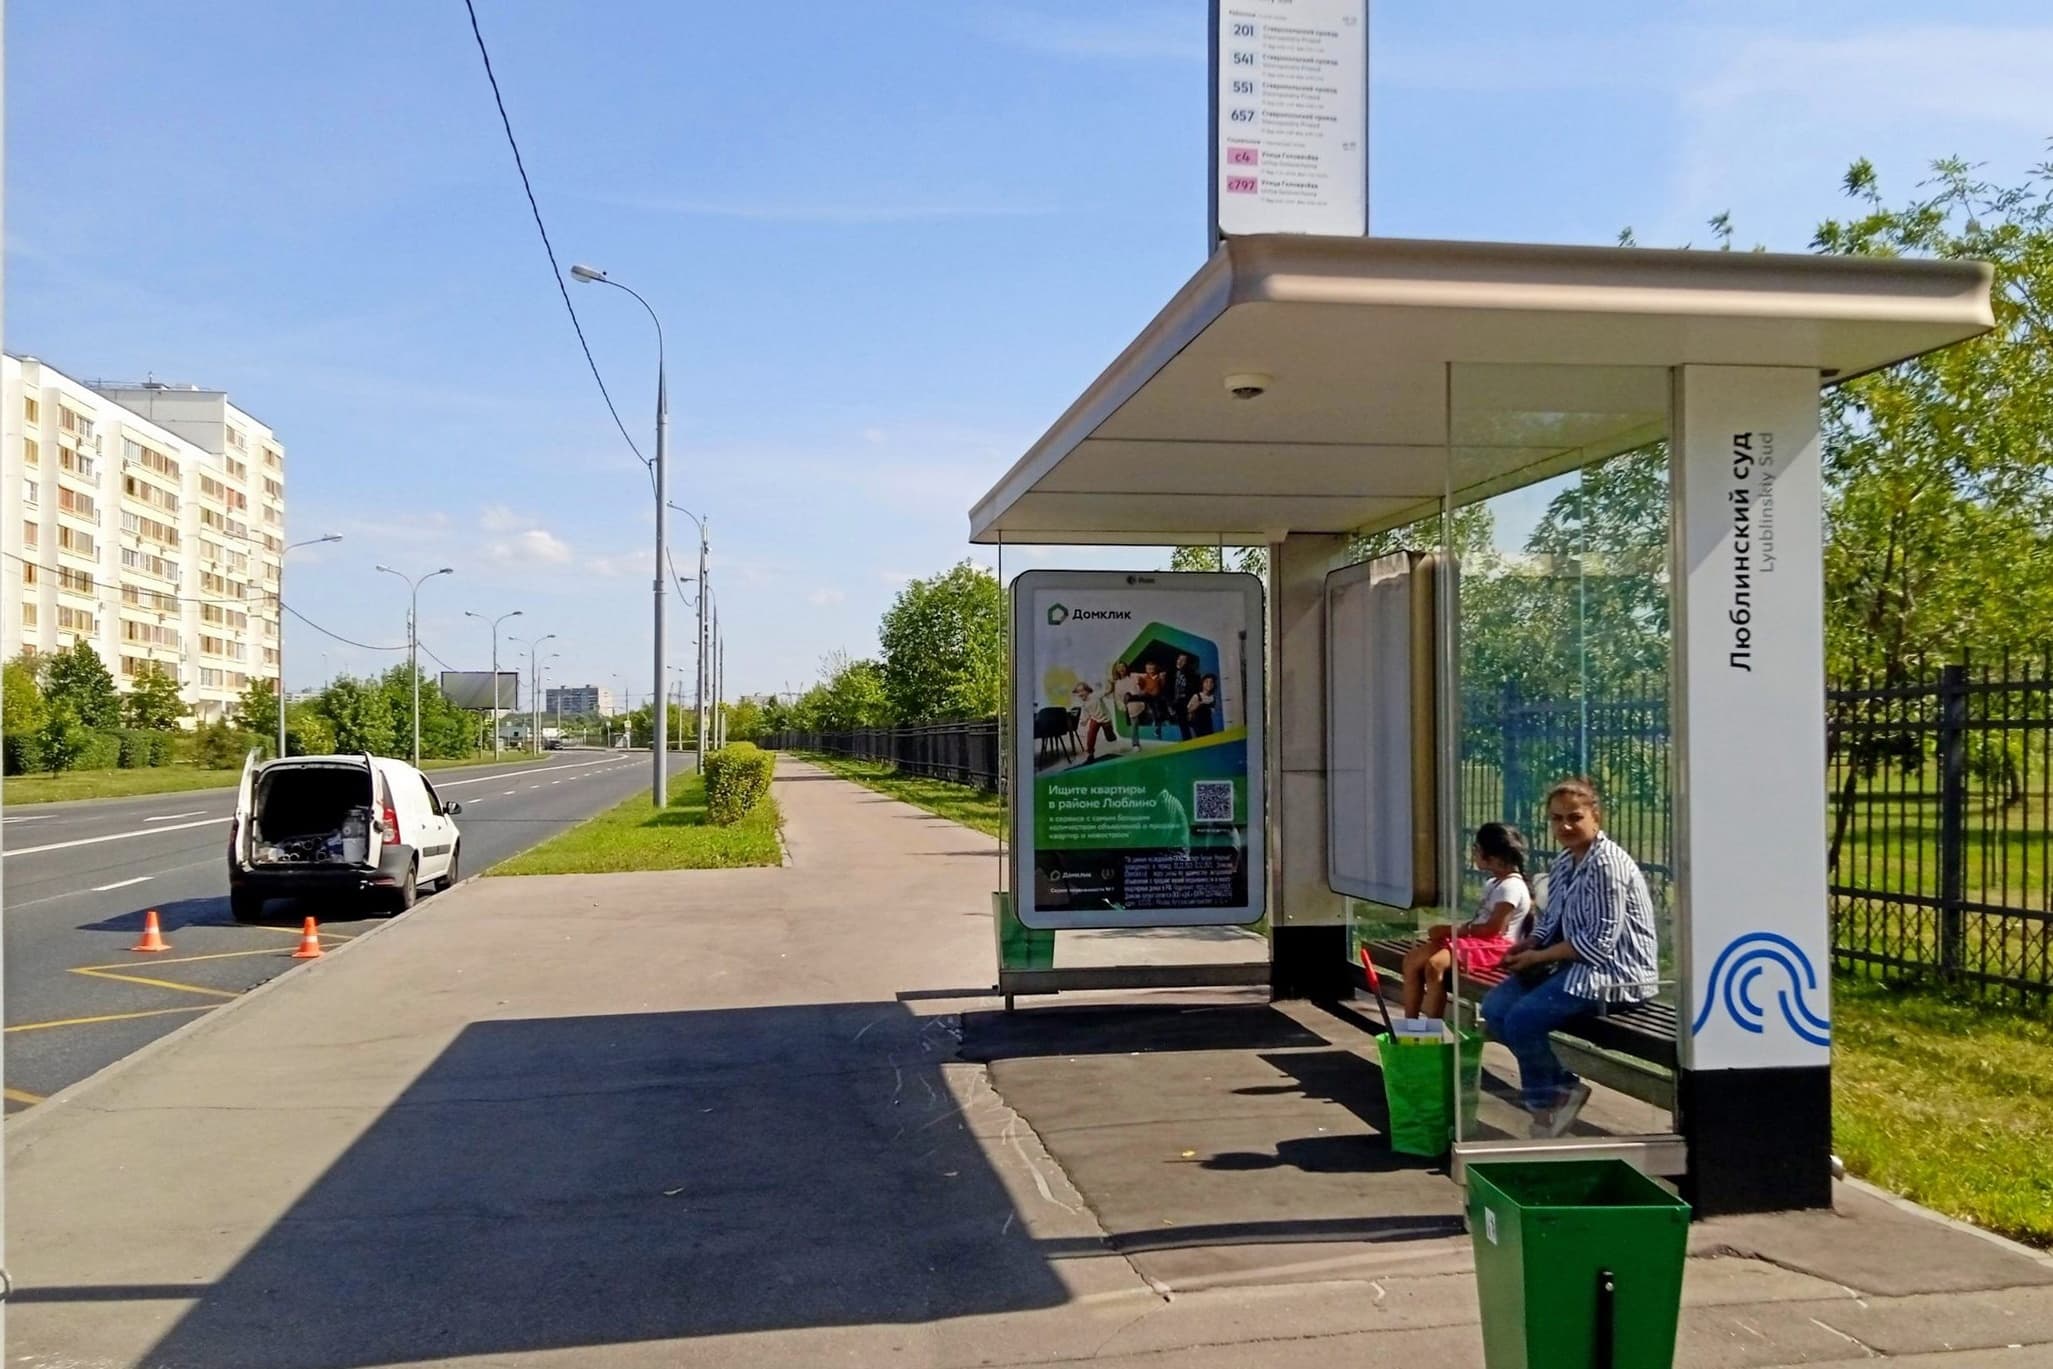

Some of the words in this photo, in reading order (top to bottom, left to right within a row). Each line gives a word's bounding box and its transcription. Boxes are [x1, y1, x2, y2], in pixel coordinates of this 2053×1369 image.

[1233, 23, 1254, 37] 201
[1233, 52, 1254, 66] 541
[1232, 80, 1253, 94] 551
[1231, 109, 1255, 122] 657
[1732, 432, 1754, 480] суд
[1758, 432, 1774, 467] Sud
[1758, 474, 1777, 573] Lyublinskiy
[1728, 489, 1752, 672] Люблинский
[1071, 608, 1132, 620] Домклик
[1048, 784, 1088, 796] Ищите
[1090, 785, 1147, 797] квартиры
[1048, 800, 1056, 809] в
[1058, 798, 1100, 811] районе
[1102, 796, 1158, 809] Люблино
